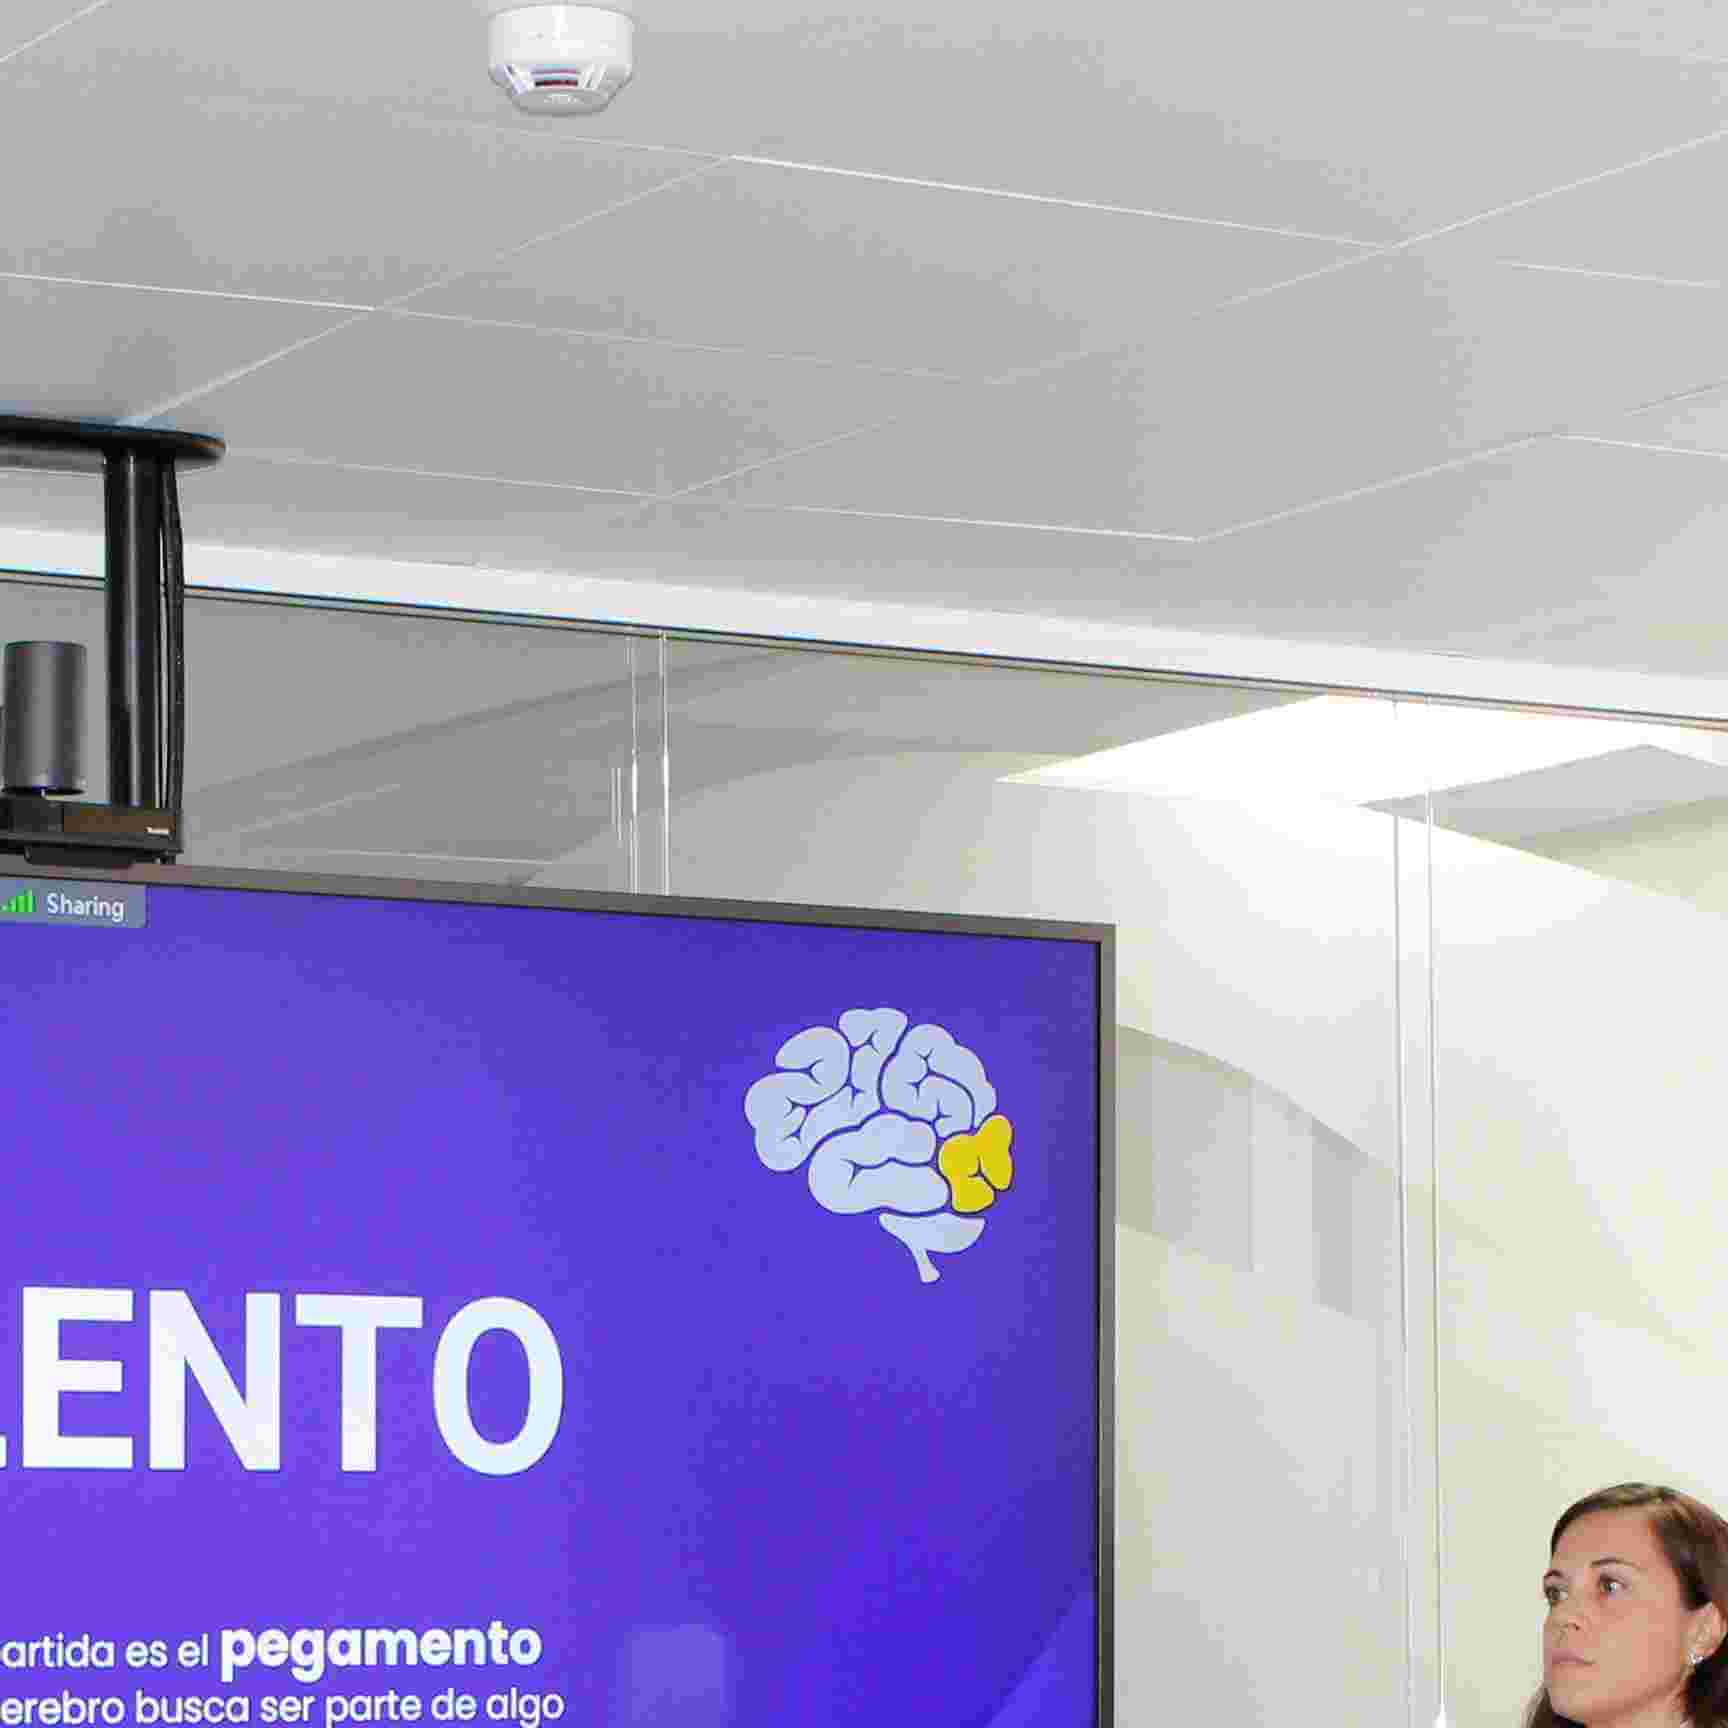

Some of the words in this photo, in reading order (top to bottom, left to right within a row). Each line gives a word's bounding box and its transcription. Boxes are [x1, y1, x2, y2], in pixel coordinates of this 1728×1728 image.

[46, 892, 124, 921] Sharing
[125, 1640, 168, 1668] es
[177, 1632, 209, 1668] el
[221, 1620, 542, 1683] pegamento
[135, 1689, 250, 1725] busca
[260, 1695, 316, 1723] ser
[431, 1687, 478, 1721] de
